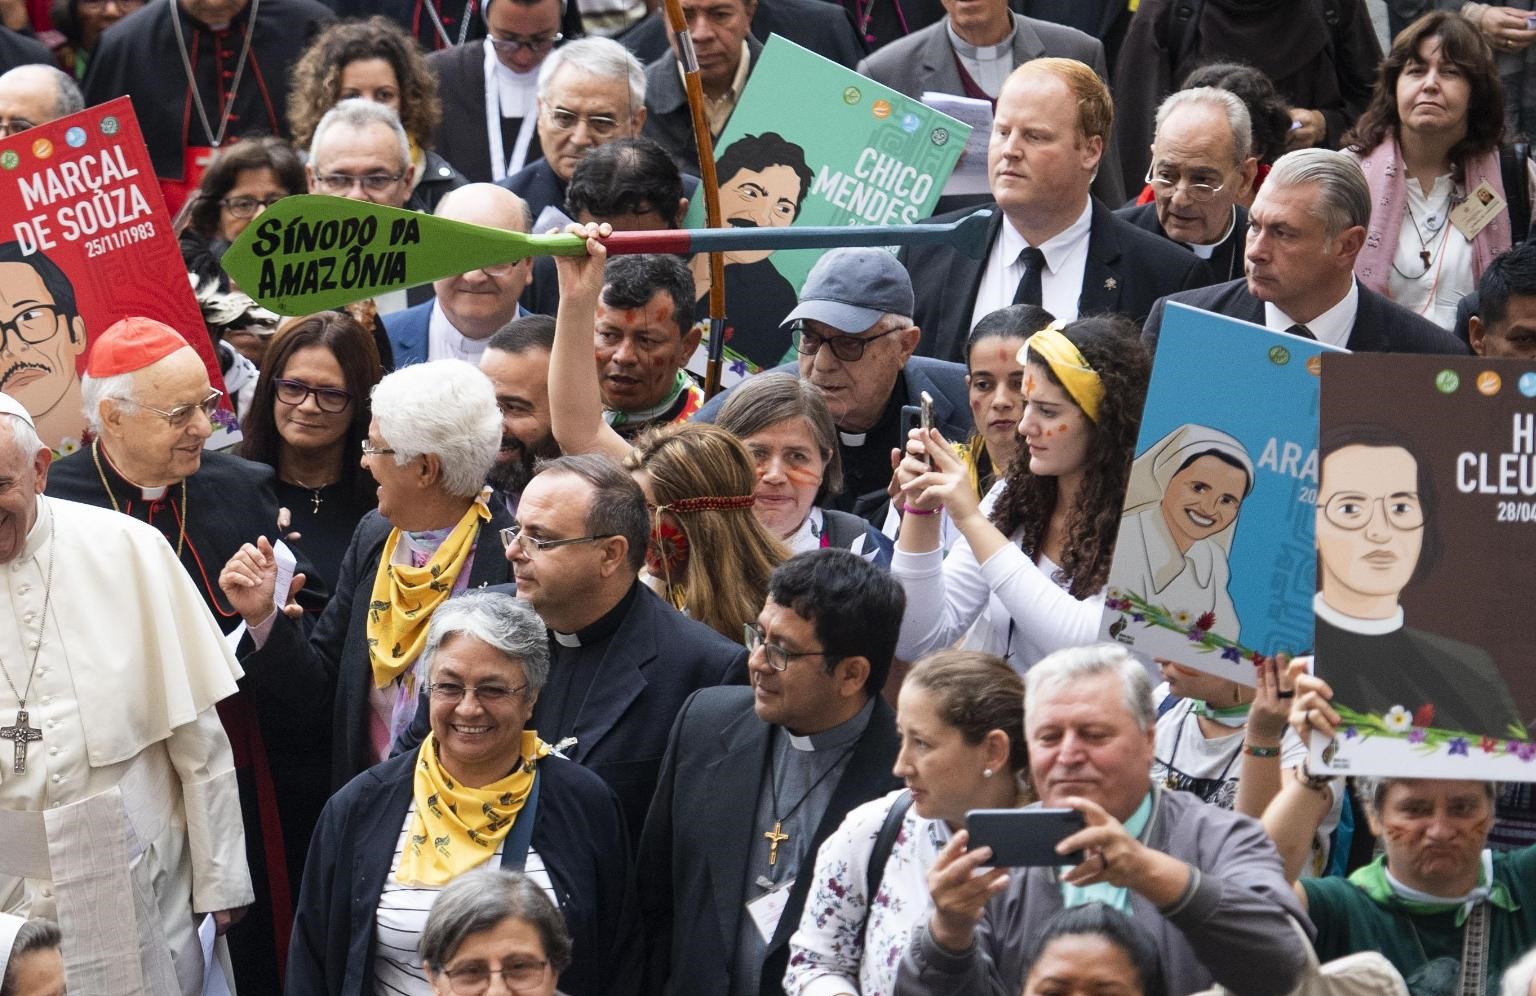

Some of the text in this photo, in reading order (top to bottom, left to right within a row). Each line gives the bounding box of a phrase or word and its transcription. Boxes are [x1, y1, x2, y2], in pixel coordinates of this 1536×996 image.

[17, 144, 139, 211] MARÇAL
[812, 164, 919, 226] MENDES
[855, 147, 933, 204] CHICO
[13, 184, 153, 257] DE SOUZA
[85, 221, 155, 258] 25/11/1983
[252, 215, 421, 257] SÍNODO DA
[259, 245, 407, 299] AMAZÔNIA
